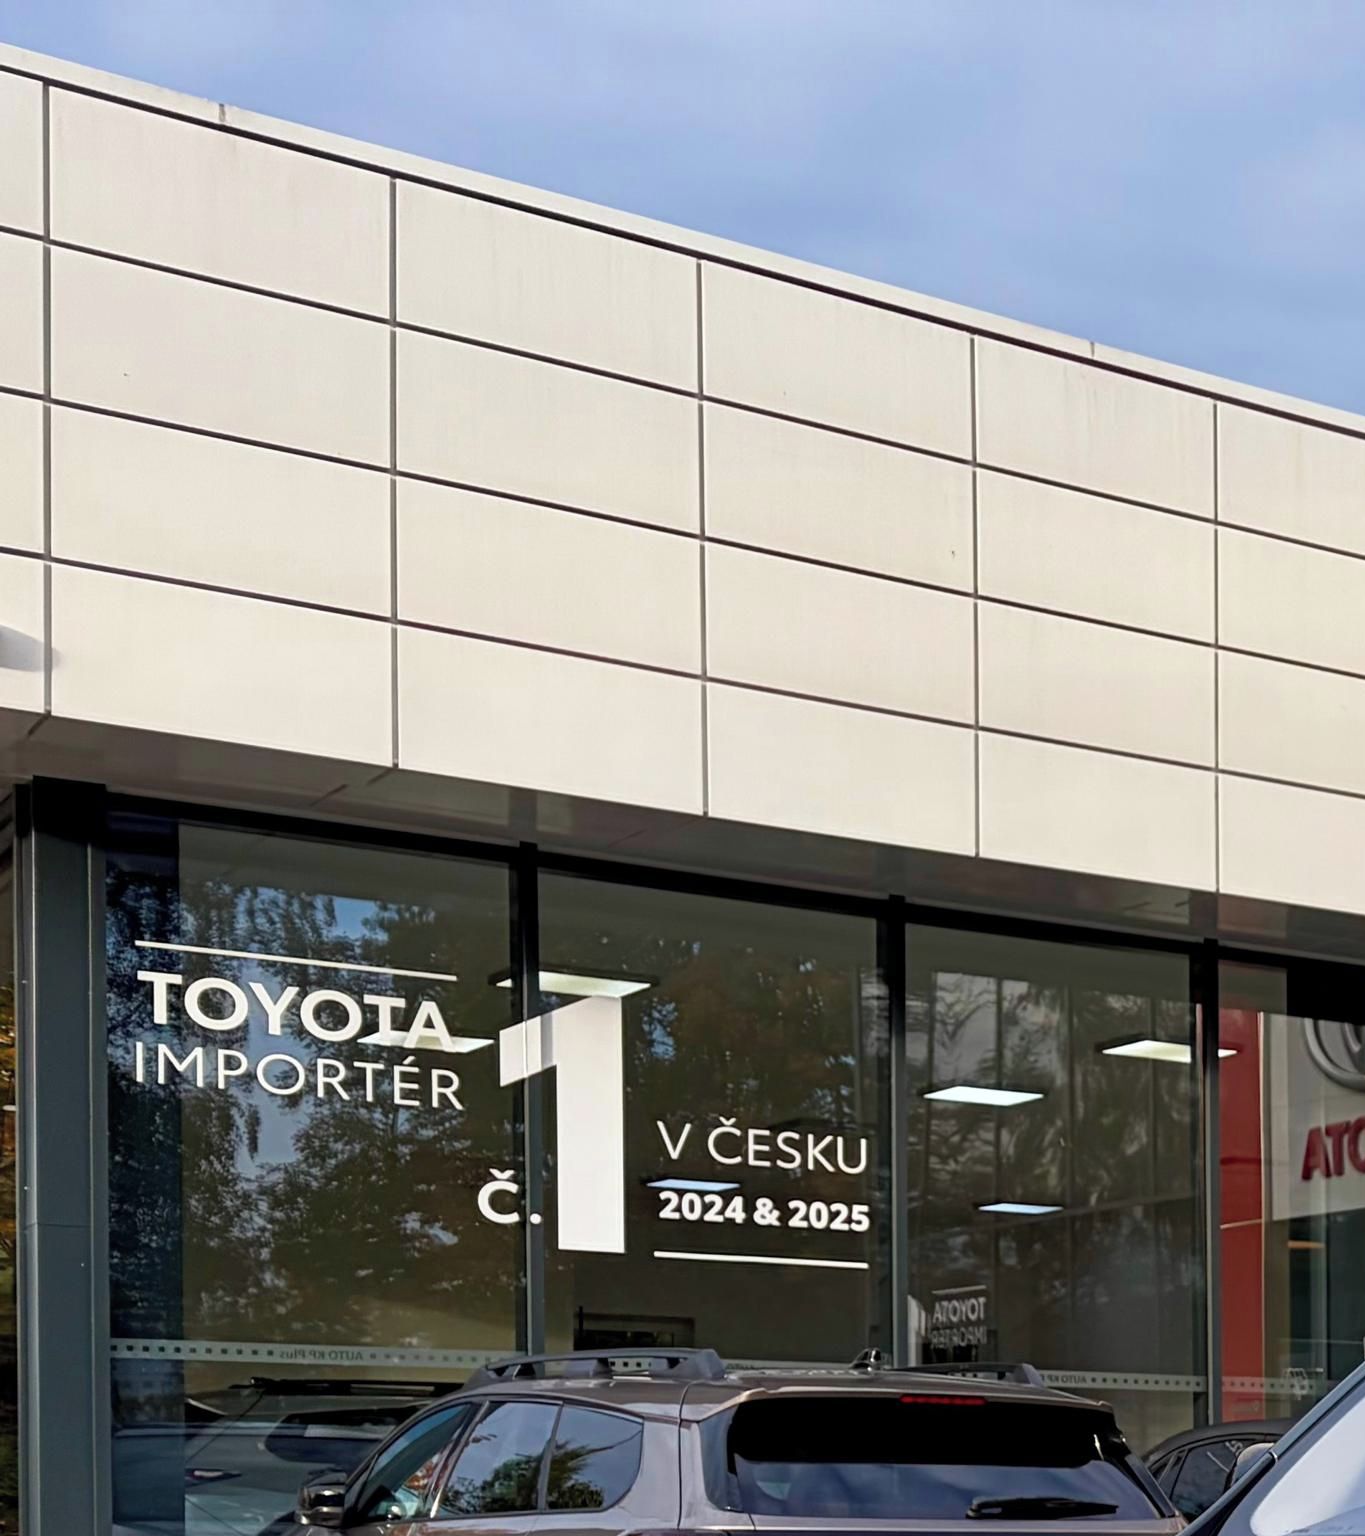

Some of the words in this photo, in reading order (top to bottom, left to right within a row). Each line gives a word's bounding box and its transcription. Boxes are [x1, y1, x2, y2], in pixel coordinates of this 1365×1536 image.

[137, 971, 454, 1052] TOYOTA
[134, 1041, 463, 1110] IMPORTÉR
[500, 994, 625, 1253] 1
[657, 1123, 688, 1160] V
[707, 1117, 868, 1175] ČESKU
[477, 1168, 542, 1225] Č.
[660, 1192, 746, 1224] 2024
[752, 1199, 781, 1227] &
[788, 1201, 870, 1232] 2025
